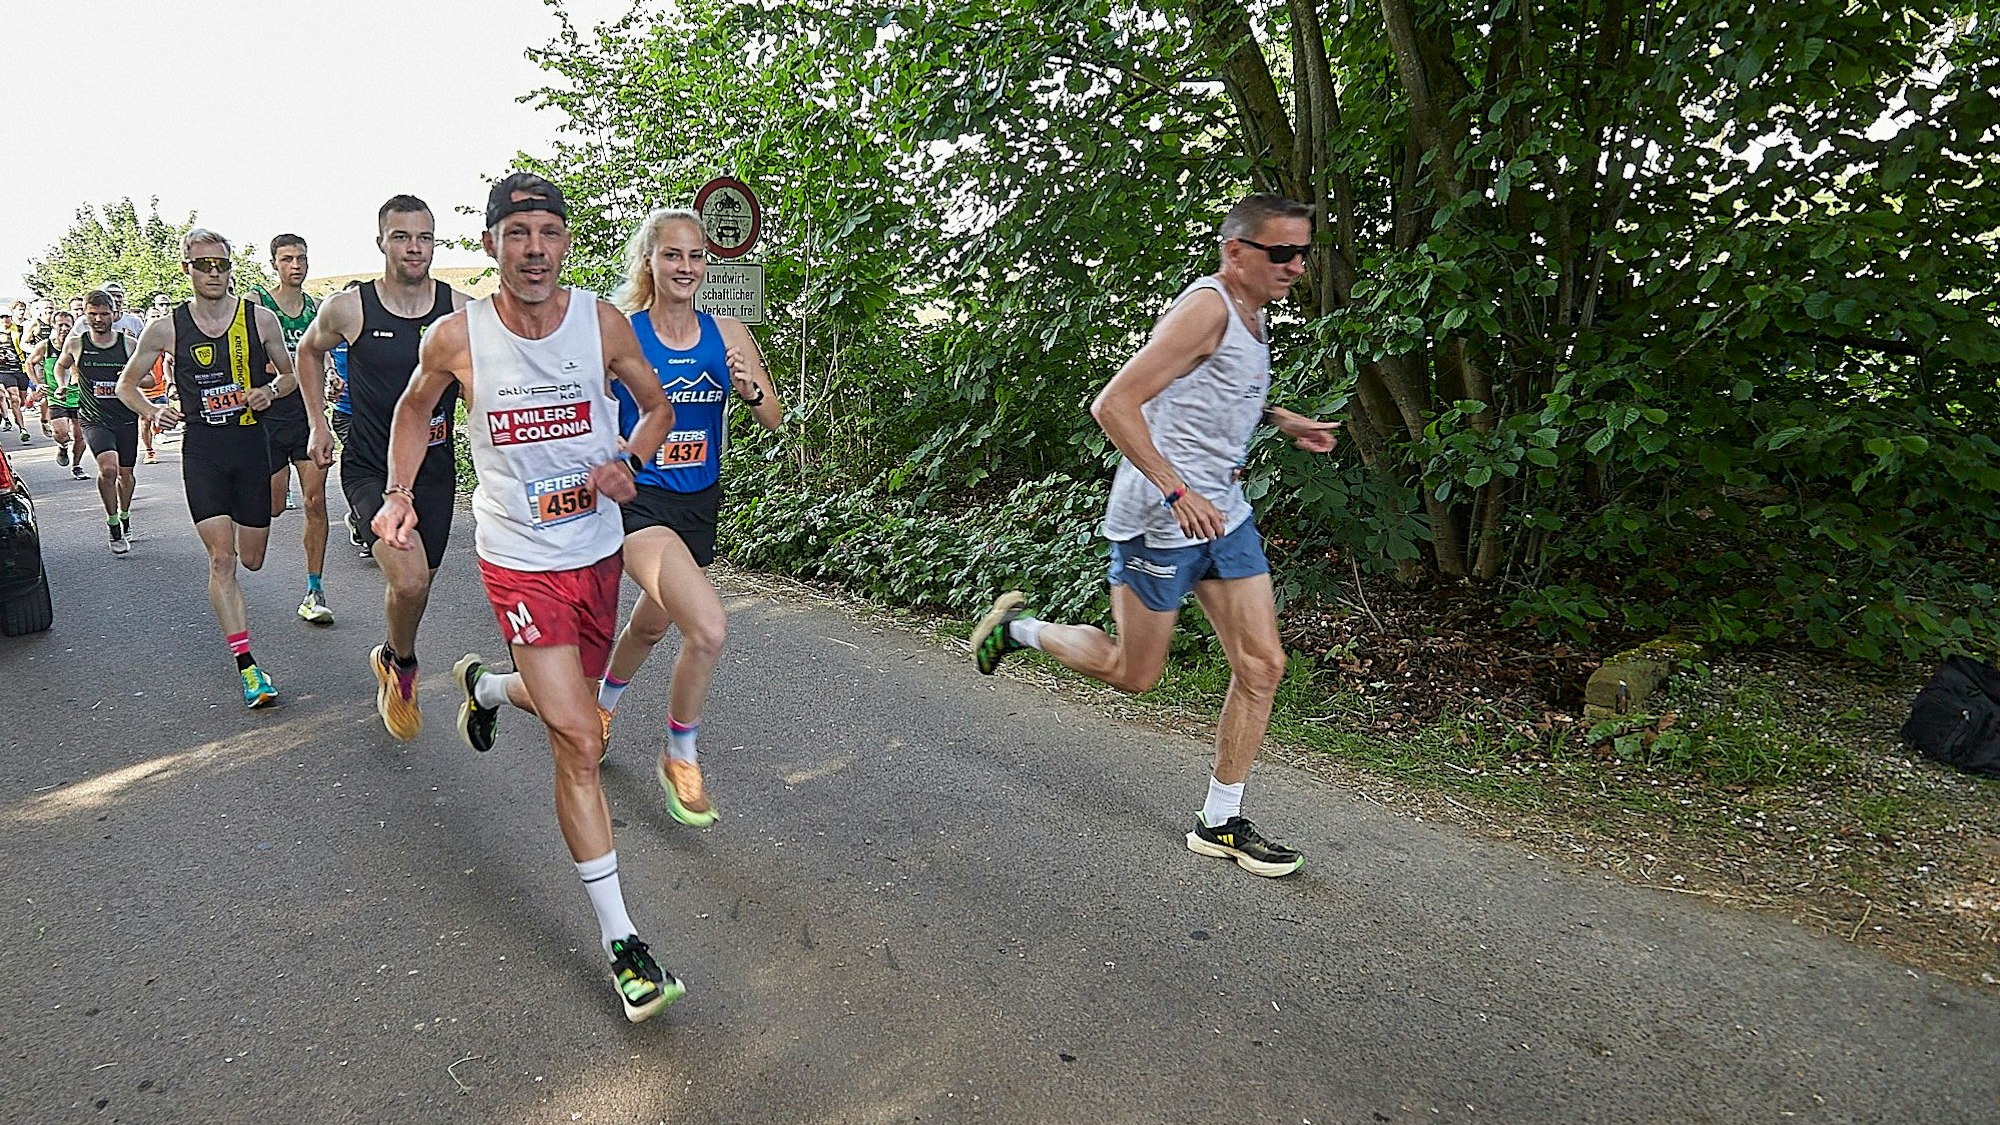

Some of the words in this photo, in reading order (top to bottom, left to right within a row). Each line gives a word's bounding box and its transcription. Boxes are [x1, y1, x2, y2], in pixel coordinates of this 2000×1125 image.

[706, 271, 750, 284] Landwirt-
[702, 288, 754, 300] schaftlicher
[702, 304, 736, 316] Verkehr
[740, 304, 755, 316] frei
[203, 384, 239, 396] PETERS
[211, 392, 239, 410] 341
[513, 406, 577, 426] MILERS
[514, 419, 591, 441] COLONIA
[668, 443, 704, 462] 437
[534, 472, 590, 494] PETERS
[547, 488, 592, 516] 456
